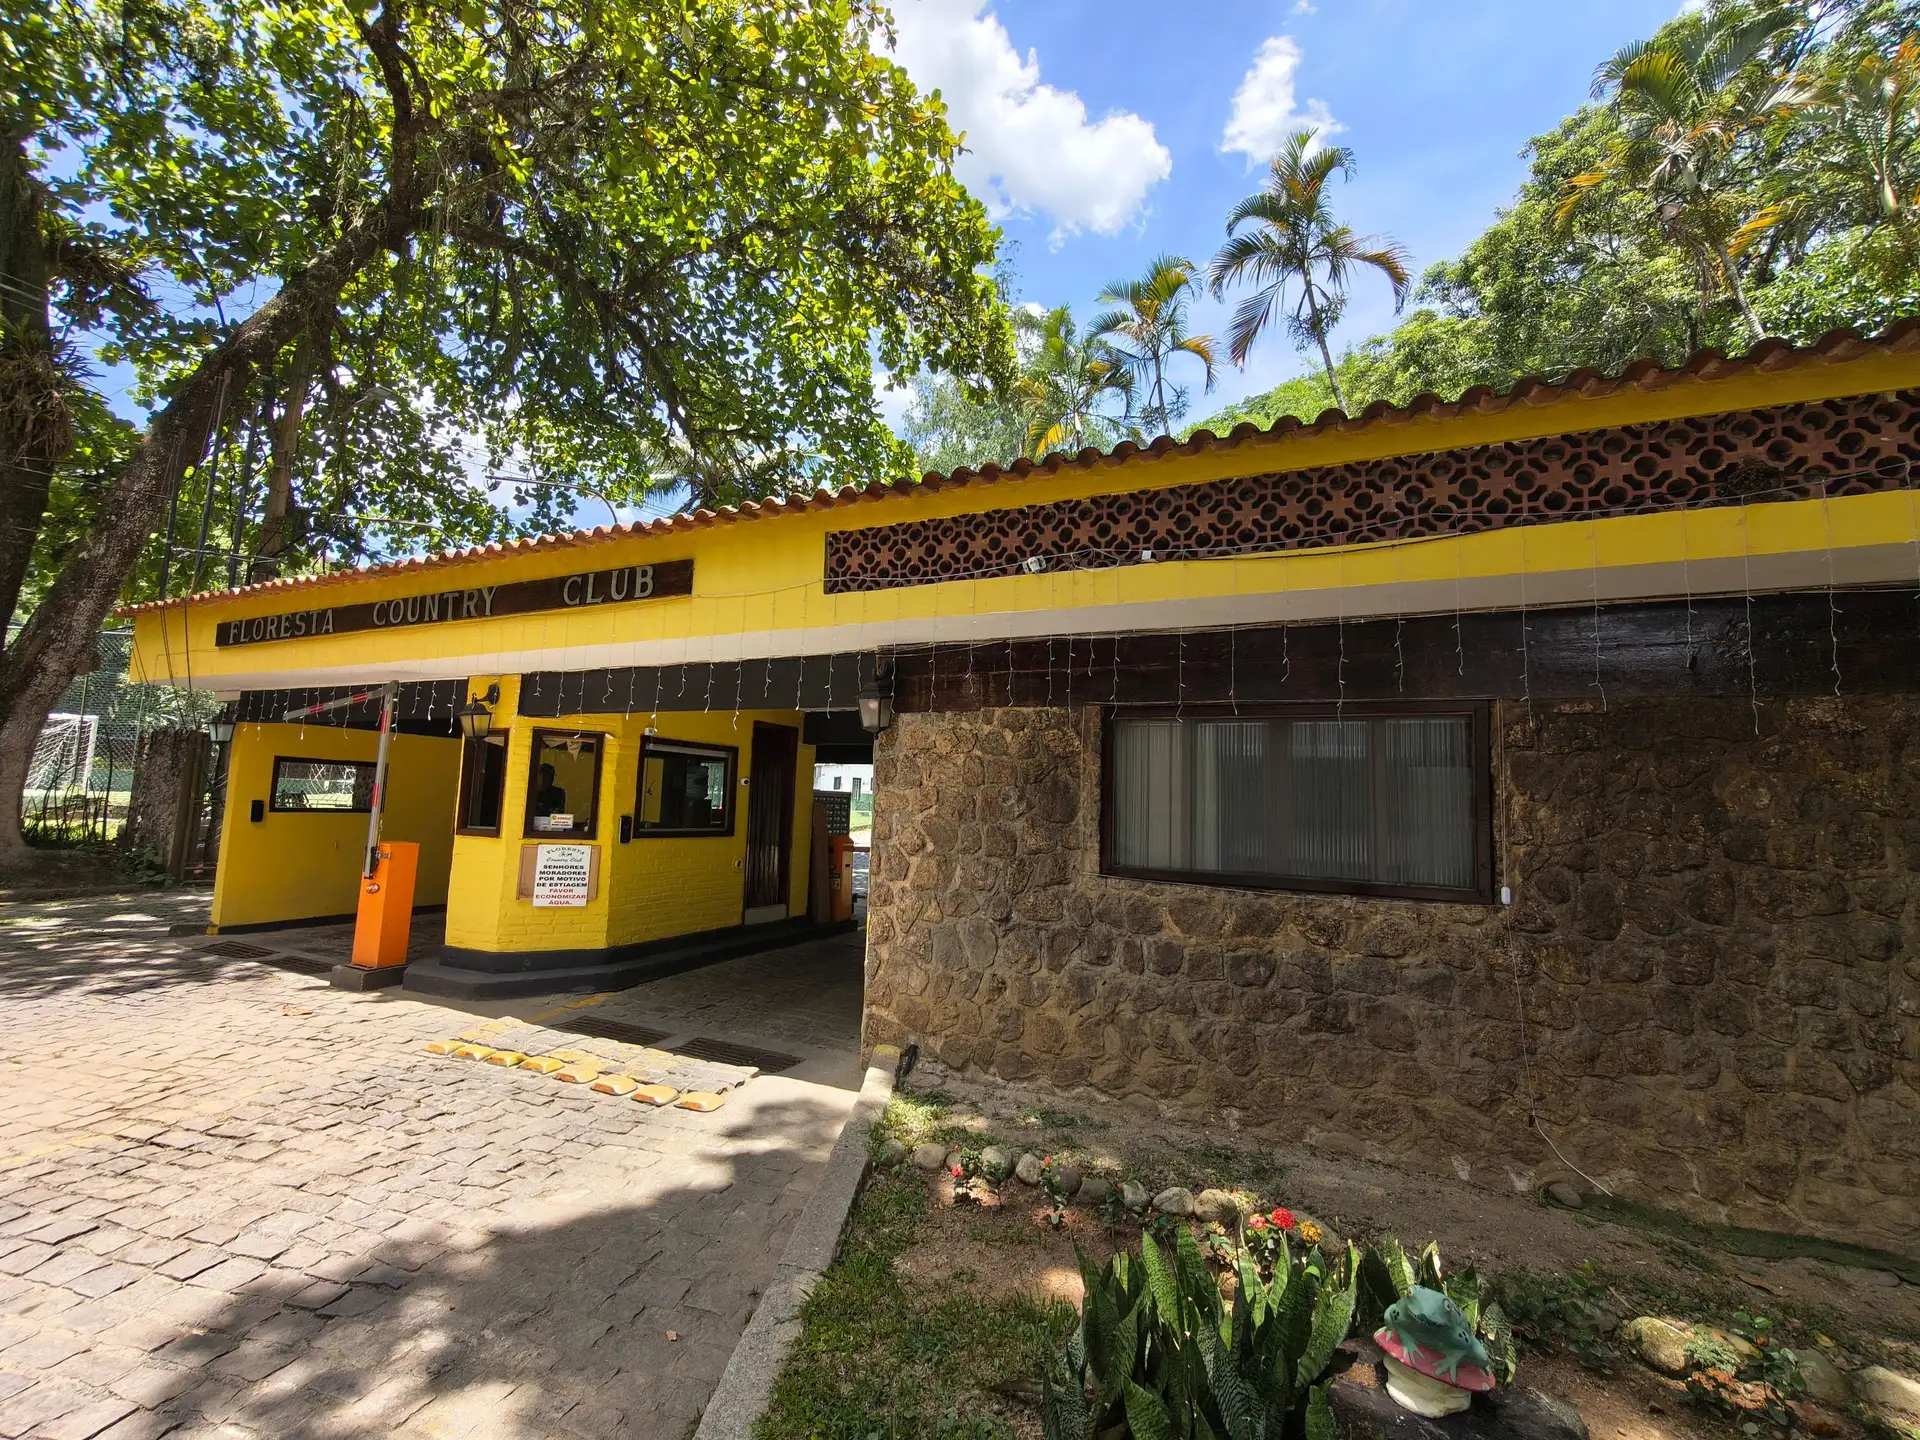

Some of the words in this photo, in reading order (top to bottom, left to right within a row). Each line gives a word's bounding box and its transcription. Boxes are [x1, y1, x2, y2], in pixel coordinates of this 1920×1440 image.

[229, 608, 333, 644] FLORESTA
[373, 586, 497, 626] COUNTRY
[563, 565, 654, 606] CLUB
[546, 846, 585, 855] FLORESTA
